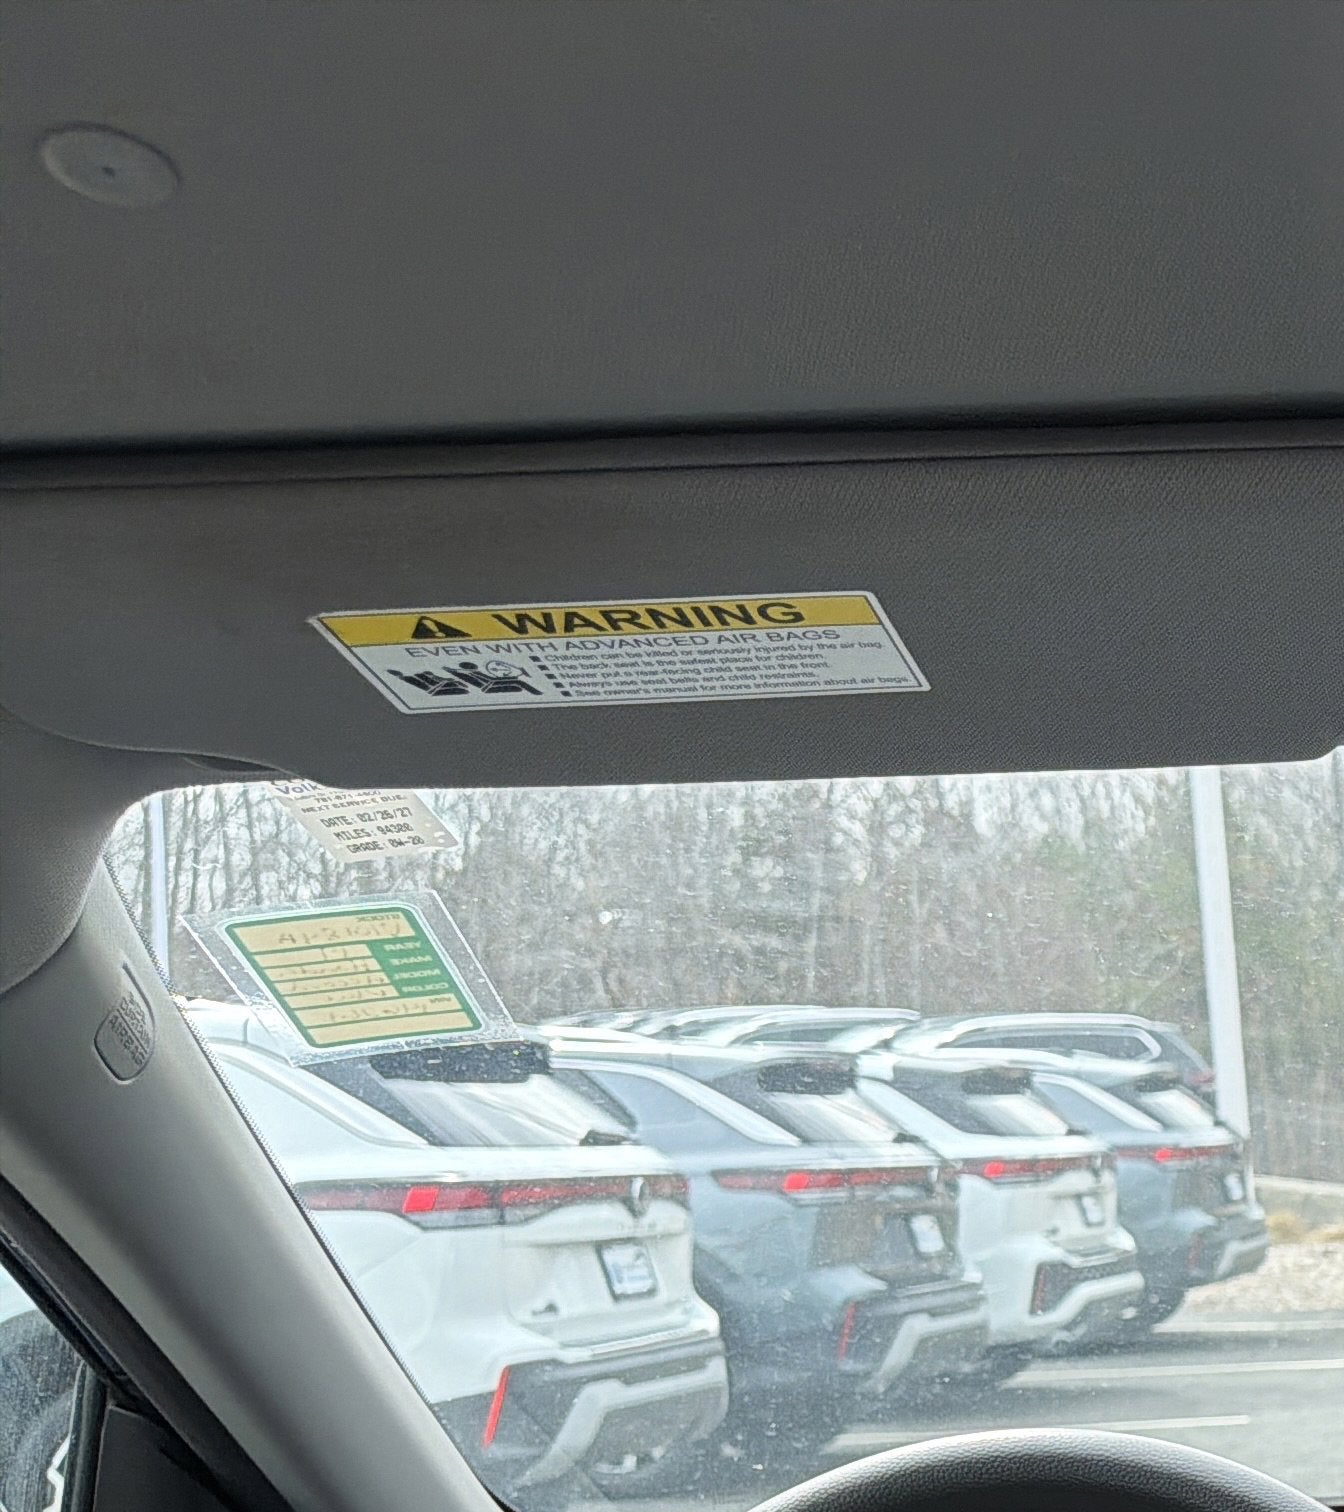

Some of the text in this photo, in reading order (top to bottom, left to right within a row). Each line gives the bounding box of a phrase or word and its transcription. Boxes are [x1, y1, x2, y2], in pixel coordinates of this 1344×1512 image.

[490, 601, 810, 635] WARNING
[401, 629, 844, 657] EVEN WITH ADVANCED AIR BAGS
[541, 641, 858, 662] Children can be killed or seriously injured by the air
[549, 662, 578, 670] The
[577, 661, 612, 669] back
[609, 659, 642, 668] seat
[653, 658, 679, 666] the
[677, 656, 718, 665] safest
[716, 655, 755, 665] place
[752, 654, 774, 662] for
[557, 670, 599, 679] Never
[597, 669, 624, 679] put
[632, 666, 703, 678] rear-facing
[700, 665, 734, 673] child
[732, 664, 763, 672] seat
[761, 663, 777, 671] in
[776, 662, 801, 670] the
[572, 677, 877, 697] See owner's manual for more information about air
[320, 815, 355, 828] DATE:
[333, 828, 375, 841] MILES:
